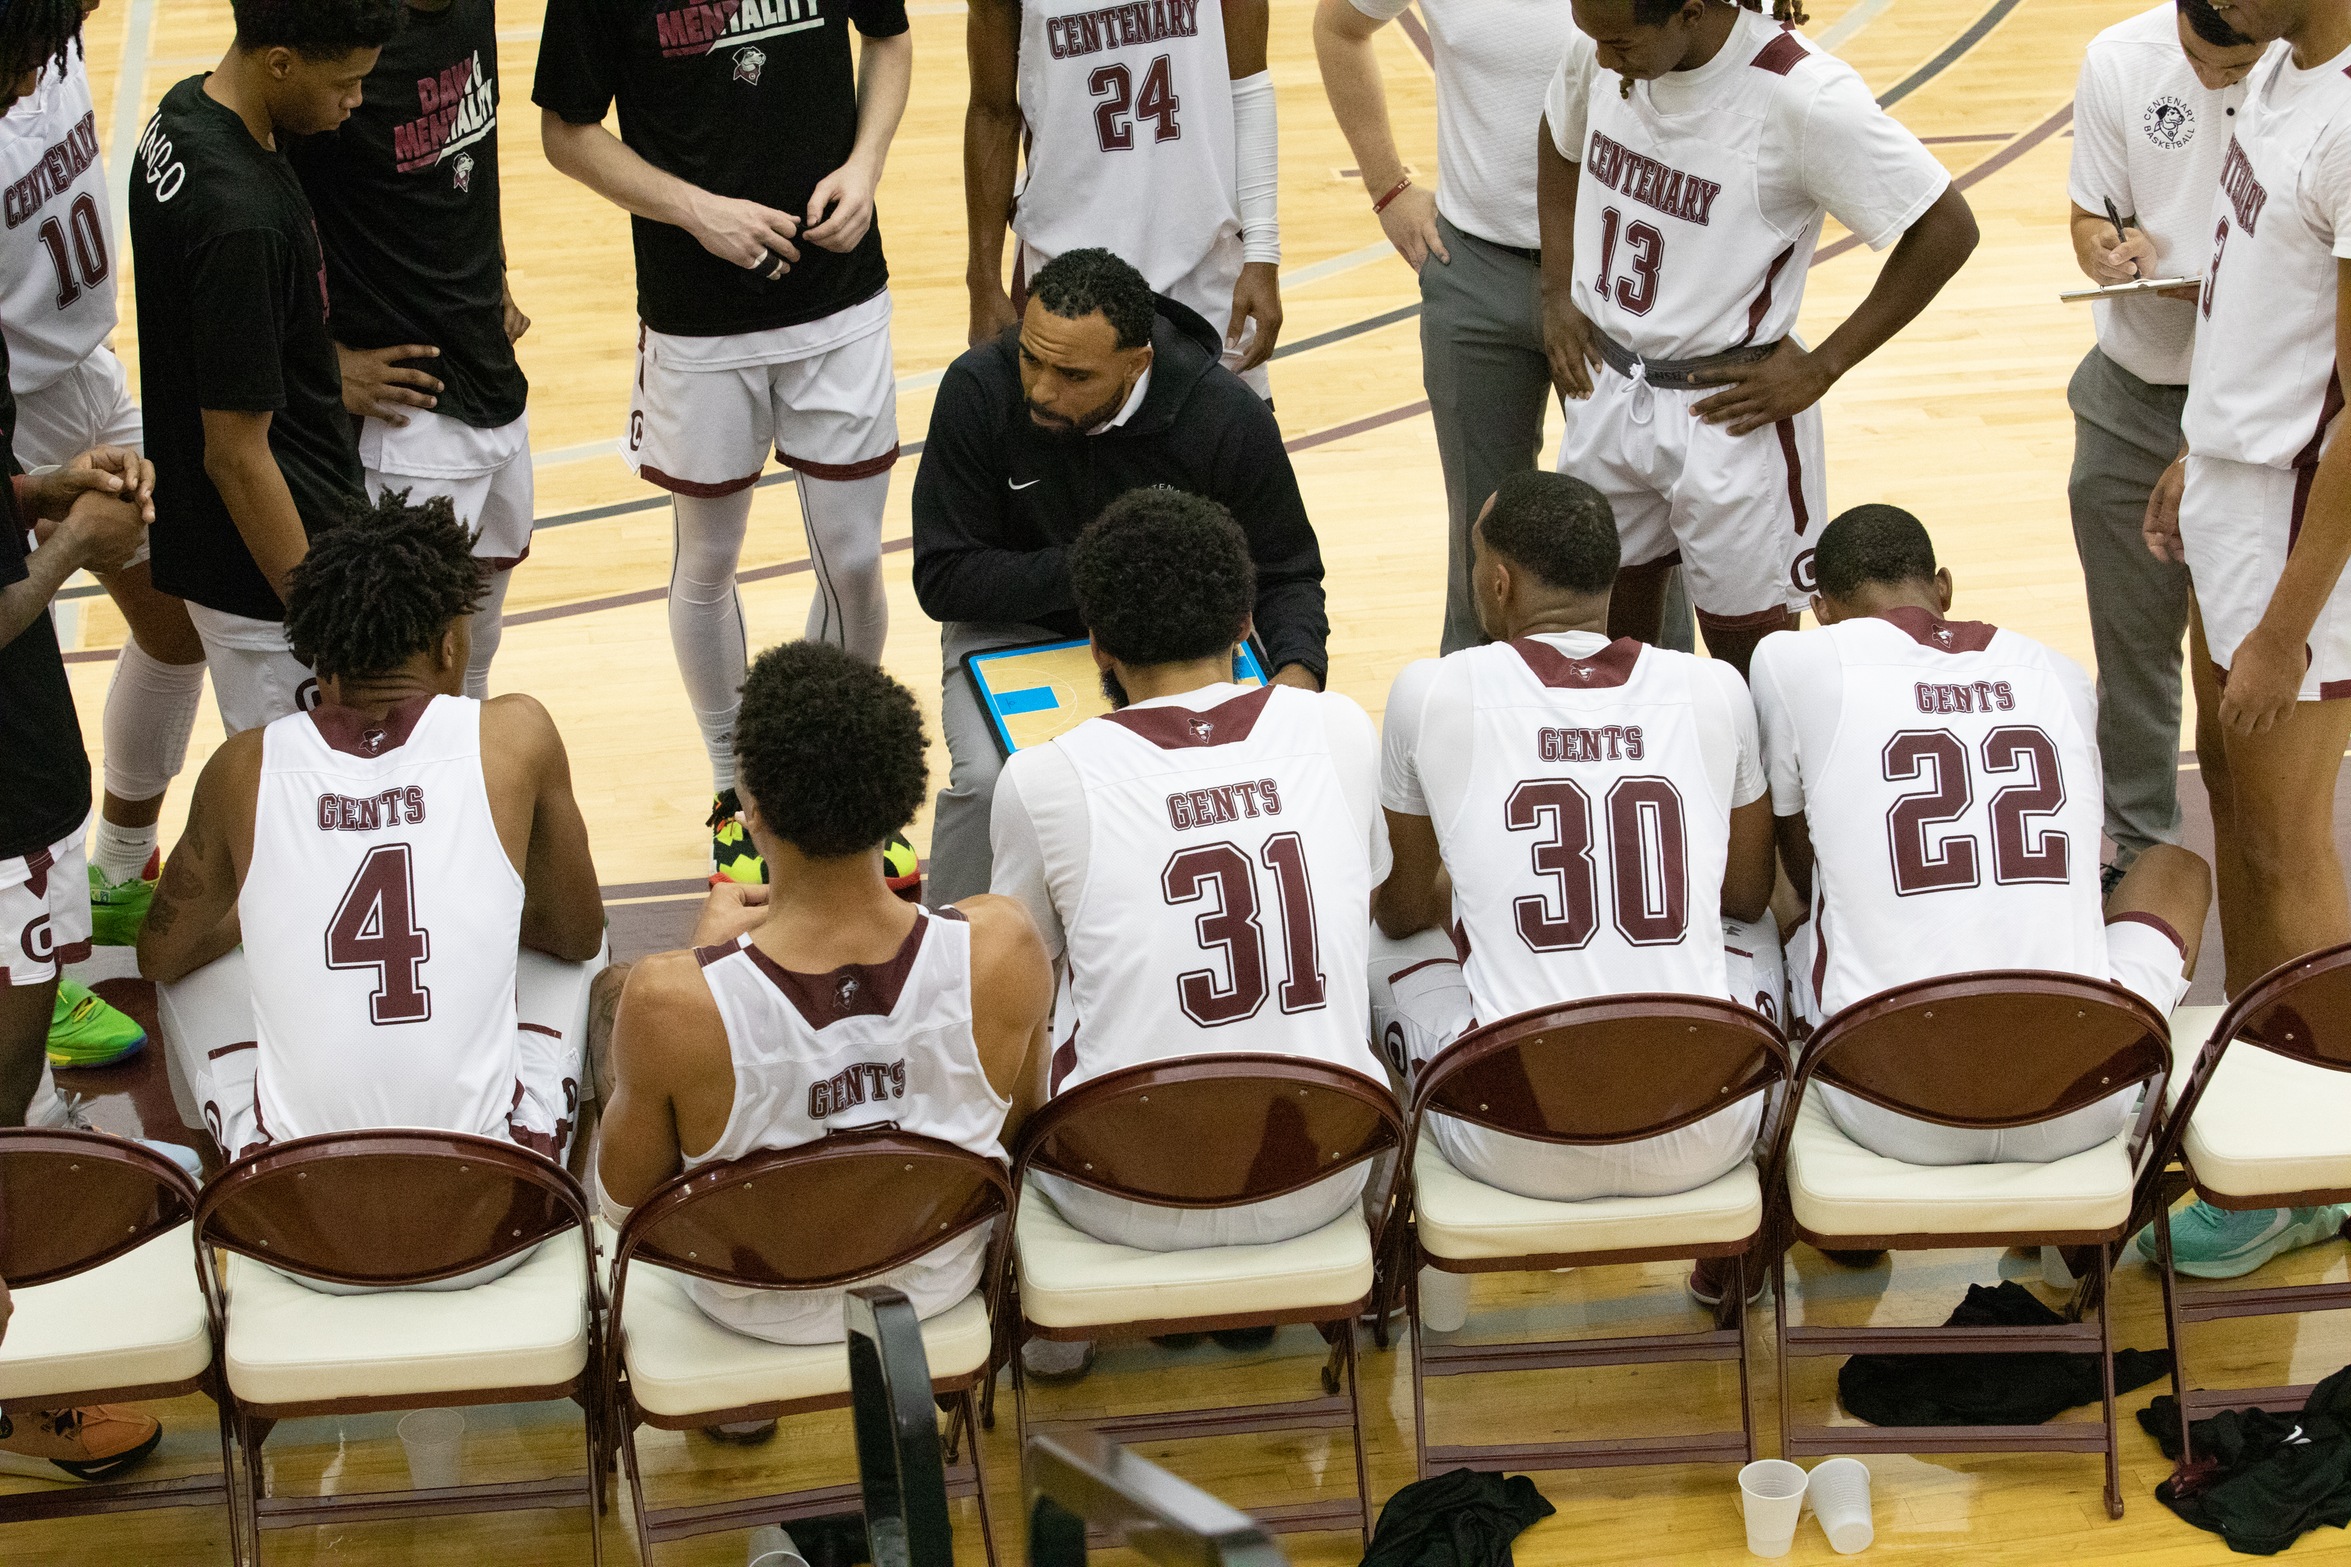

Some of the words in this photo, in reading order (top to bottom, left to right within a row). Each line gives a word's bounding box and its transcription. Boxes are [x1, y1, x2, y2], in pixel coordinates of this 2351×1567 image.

[1046, 0, 1198, 60] CENTENARY
[394, 78, 493, 161] MENTALITY
[417, 50, 483, 116] DAWG
[1088, 53, 1180, 152] 24
[2143, 96, 2195, 123] CENTENARY
[3, 110, 99, 229] CENTENARY
[139, 107, 185, 203] INGO
[1587, 129, 1721, 226] CENTENARY
[2143, 125, 2195, 150] BASKETBALL
[38, 191, 109, 310] 10
[1595, 205, 1665, 318] 13
[1915, 680, 2016, 715] GENTS
[1538, 725, 1645, 763] GENTS
[317, 785, 426, 832] GENTS
[1166, 778, 1283, 832] GENTS
[1881, 725, 2071, 898] 22
[1504, 775, 1689, 954] 30
[325, 842, 431, 1026] 4
[1161, 831, 1327, 1029] 31
[808, 1058, 906, 1120] GENTS
